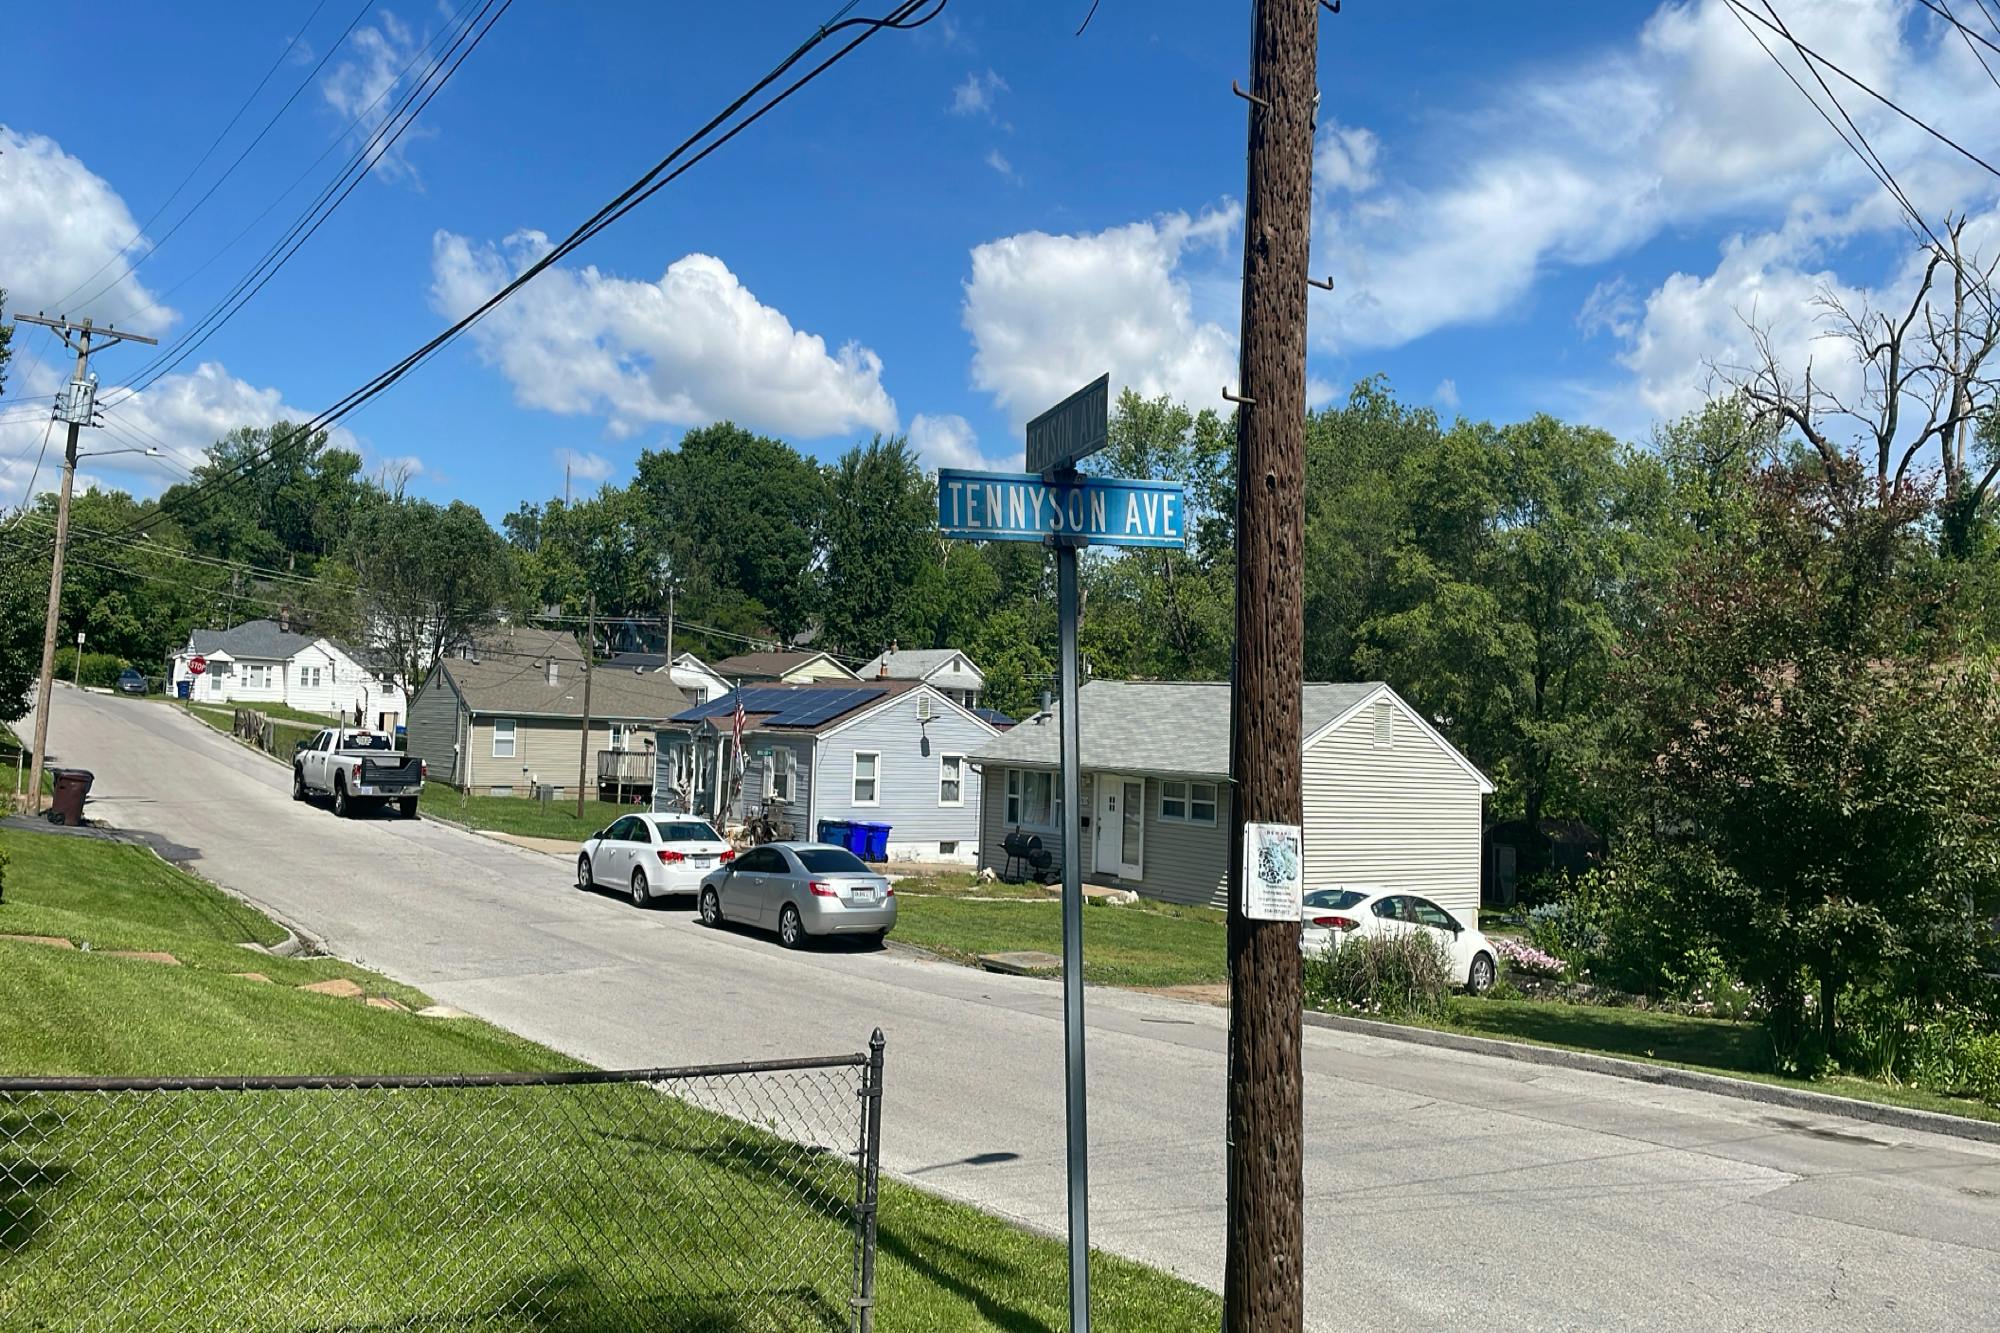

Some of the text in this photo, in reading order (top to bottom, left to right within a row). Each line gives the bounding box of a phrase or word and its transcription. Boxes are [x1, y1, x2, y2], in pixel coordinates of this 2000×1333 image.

[1080, 390, 1105, 446] AVE
[948, 482, 1177, 536] TENNYSON AVE
[190, 661, 206, 671] STOP
